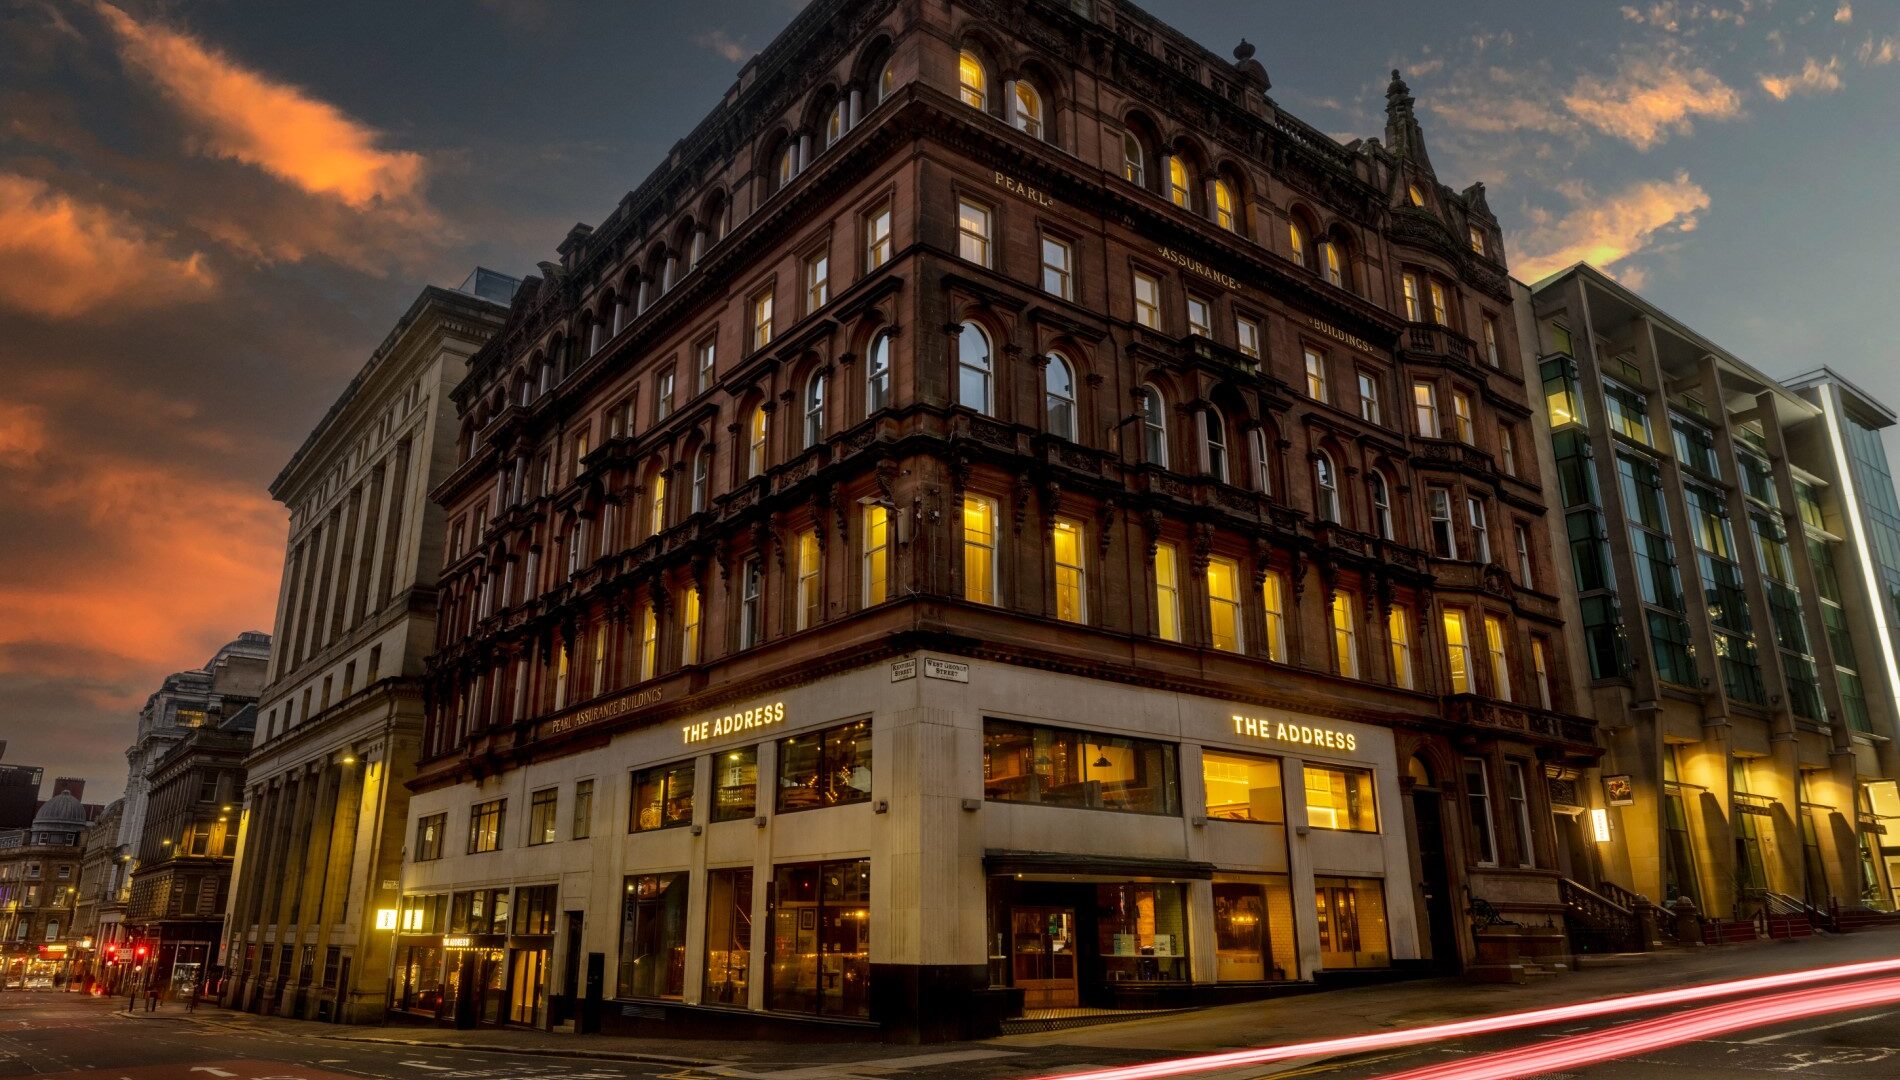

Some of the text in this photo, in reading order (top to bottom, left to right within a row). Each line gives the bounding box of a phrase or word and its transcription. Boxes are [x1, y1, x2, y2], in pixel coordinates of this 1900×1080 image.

[995, 171, 1369, 352] PEARL ASSURANCE BUILDINGS
[894, 668, 913, 677] STREET
[926, 659, 943, 668] WEST
[935, 668, 959, 677] STREET
[551, 687, 662, 734] PEARL ASSURANCE BUILDINGS
[683, 702, 784, 744] THE ADDRESS
[1232, 715, 1356, 751] THE ADDRESS
